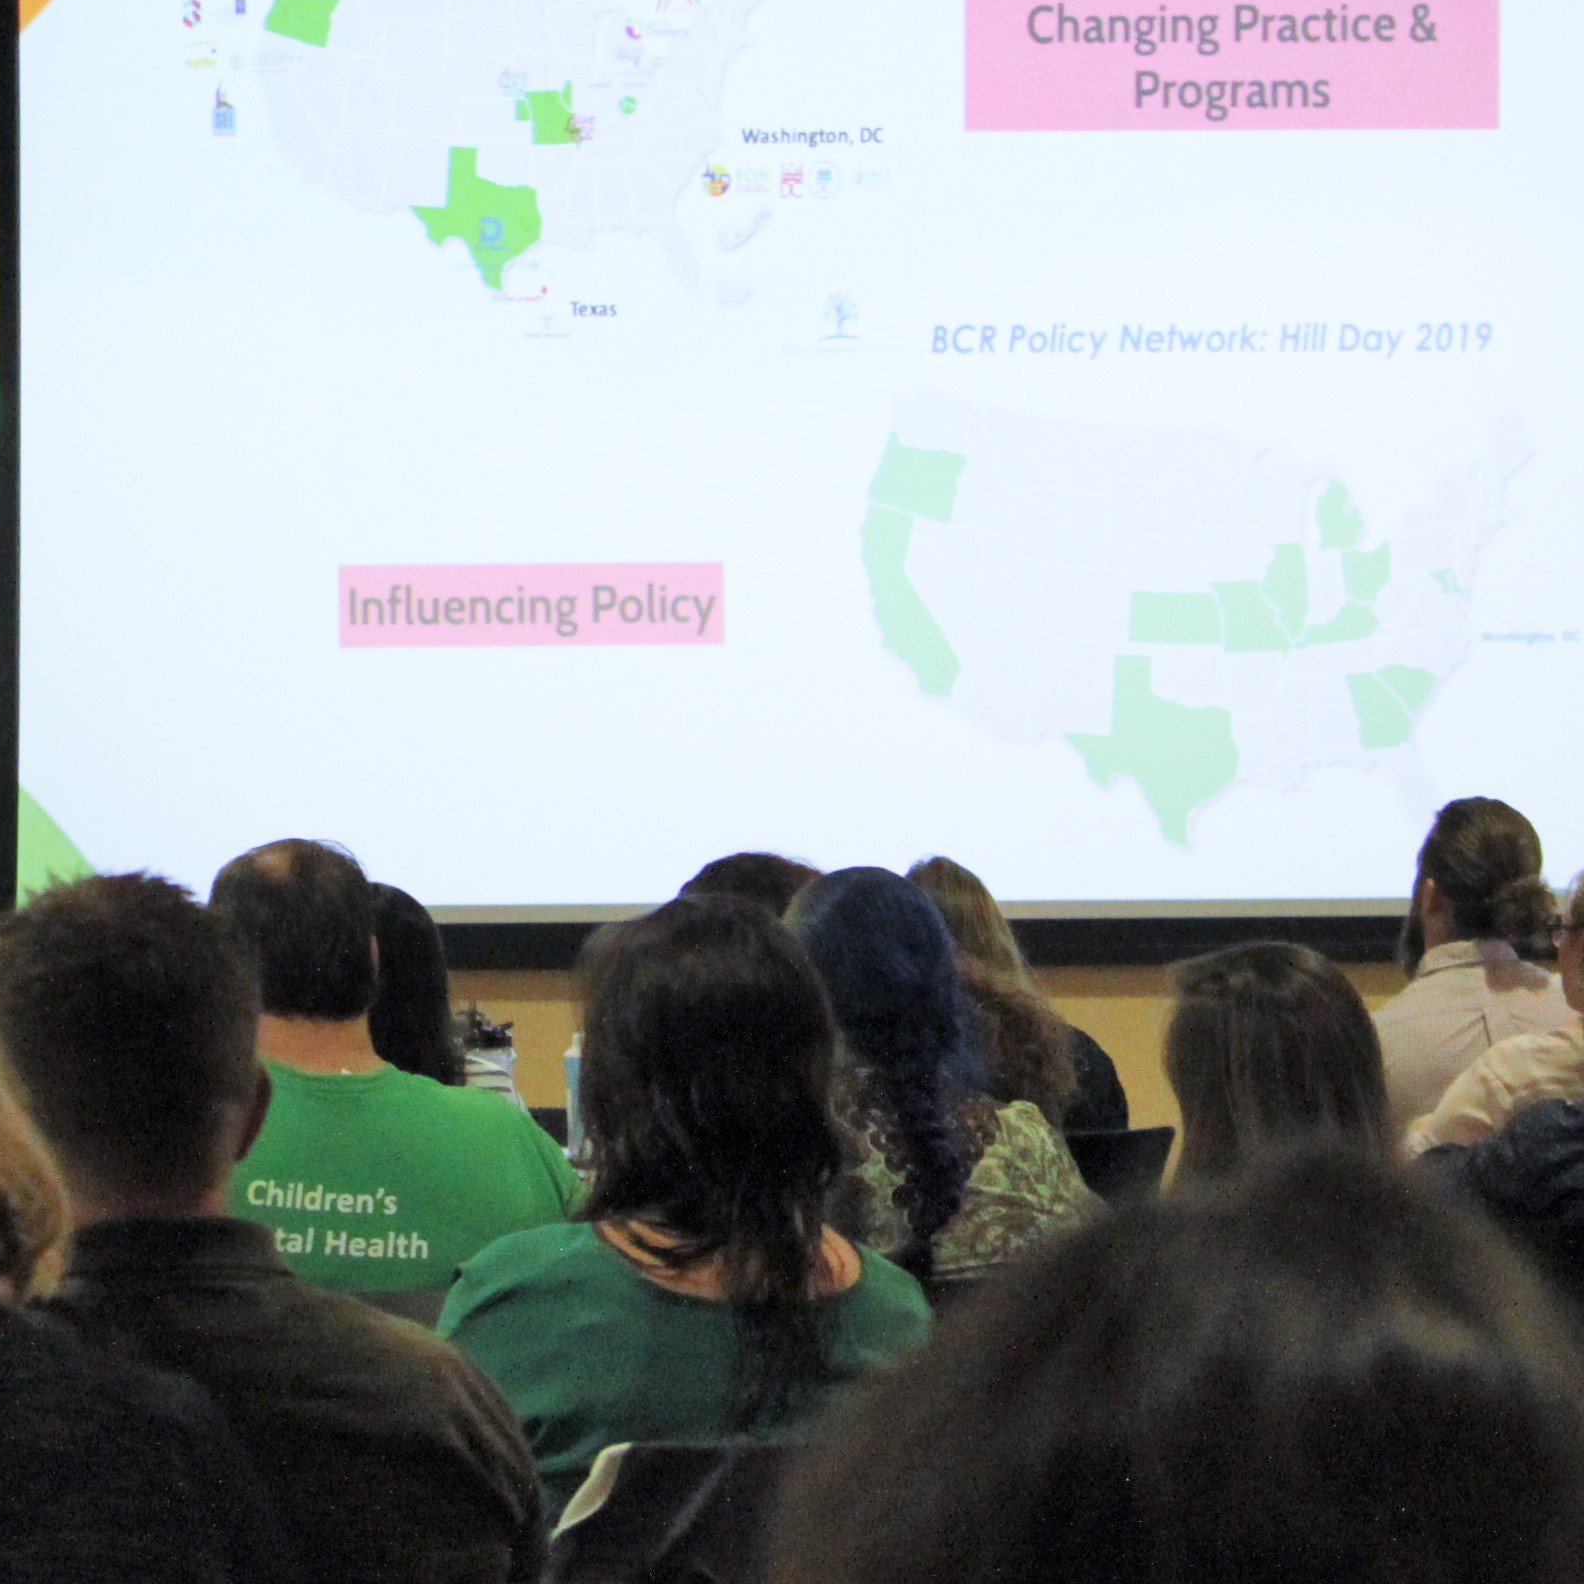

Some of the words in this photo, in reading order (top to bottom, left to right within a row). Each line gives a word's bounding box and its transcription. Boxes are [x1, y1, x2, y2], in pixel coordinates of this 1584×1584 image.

[1026, 2, 1220, 57] Changing
[1233, 2, 1397, 45] Practice
[1408, 2, 1439, 45] &
[1134, 68, 1331, 124] Programs
[740, 127, 854, 148] Washington,
[859, 126, 884, 144] DC
[570, 300, 617, 318] Texas
[931, 322, 998, 355] BCR
[1008, 322, 1108, 360] Policy
[1119, 322, 1268, 355] Network:
[1279, 321, 1328, 353] Hill
[1338, 321, 1405, 359] Day
[1415, 320, 1493, 354] 2019
[347, 584, 579, 638] Influencing
[591, 582, 716, 637] Policy
[246, 1178, 398, 1216] Children’s
[273, 1227, 315, 1255] tal
[324, 1229, 429, 1260] Health
